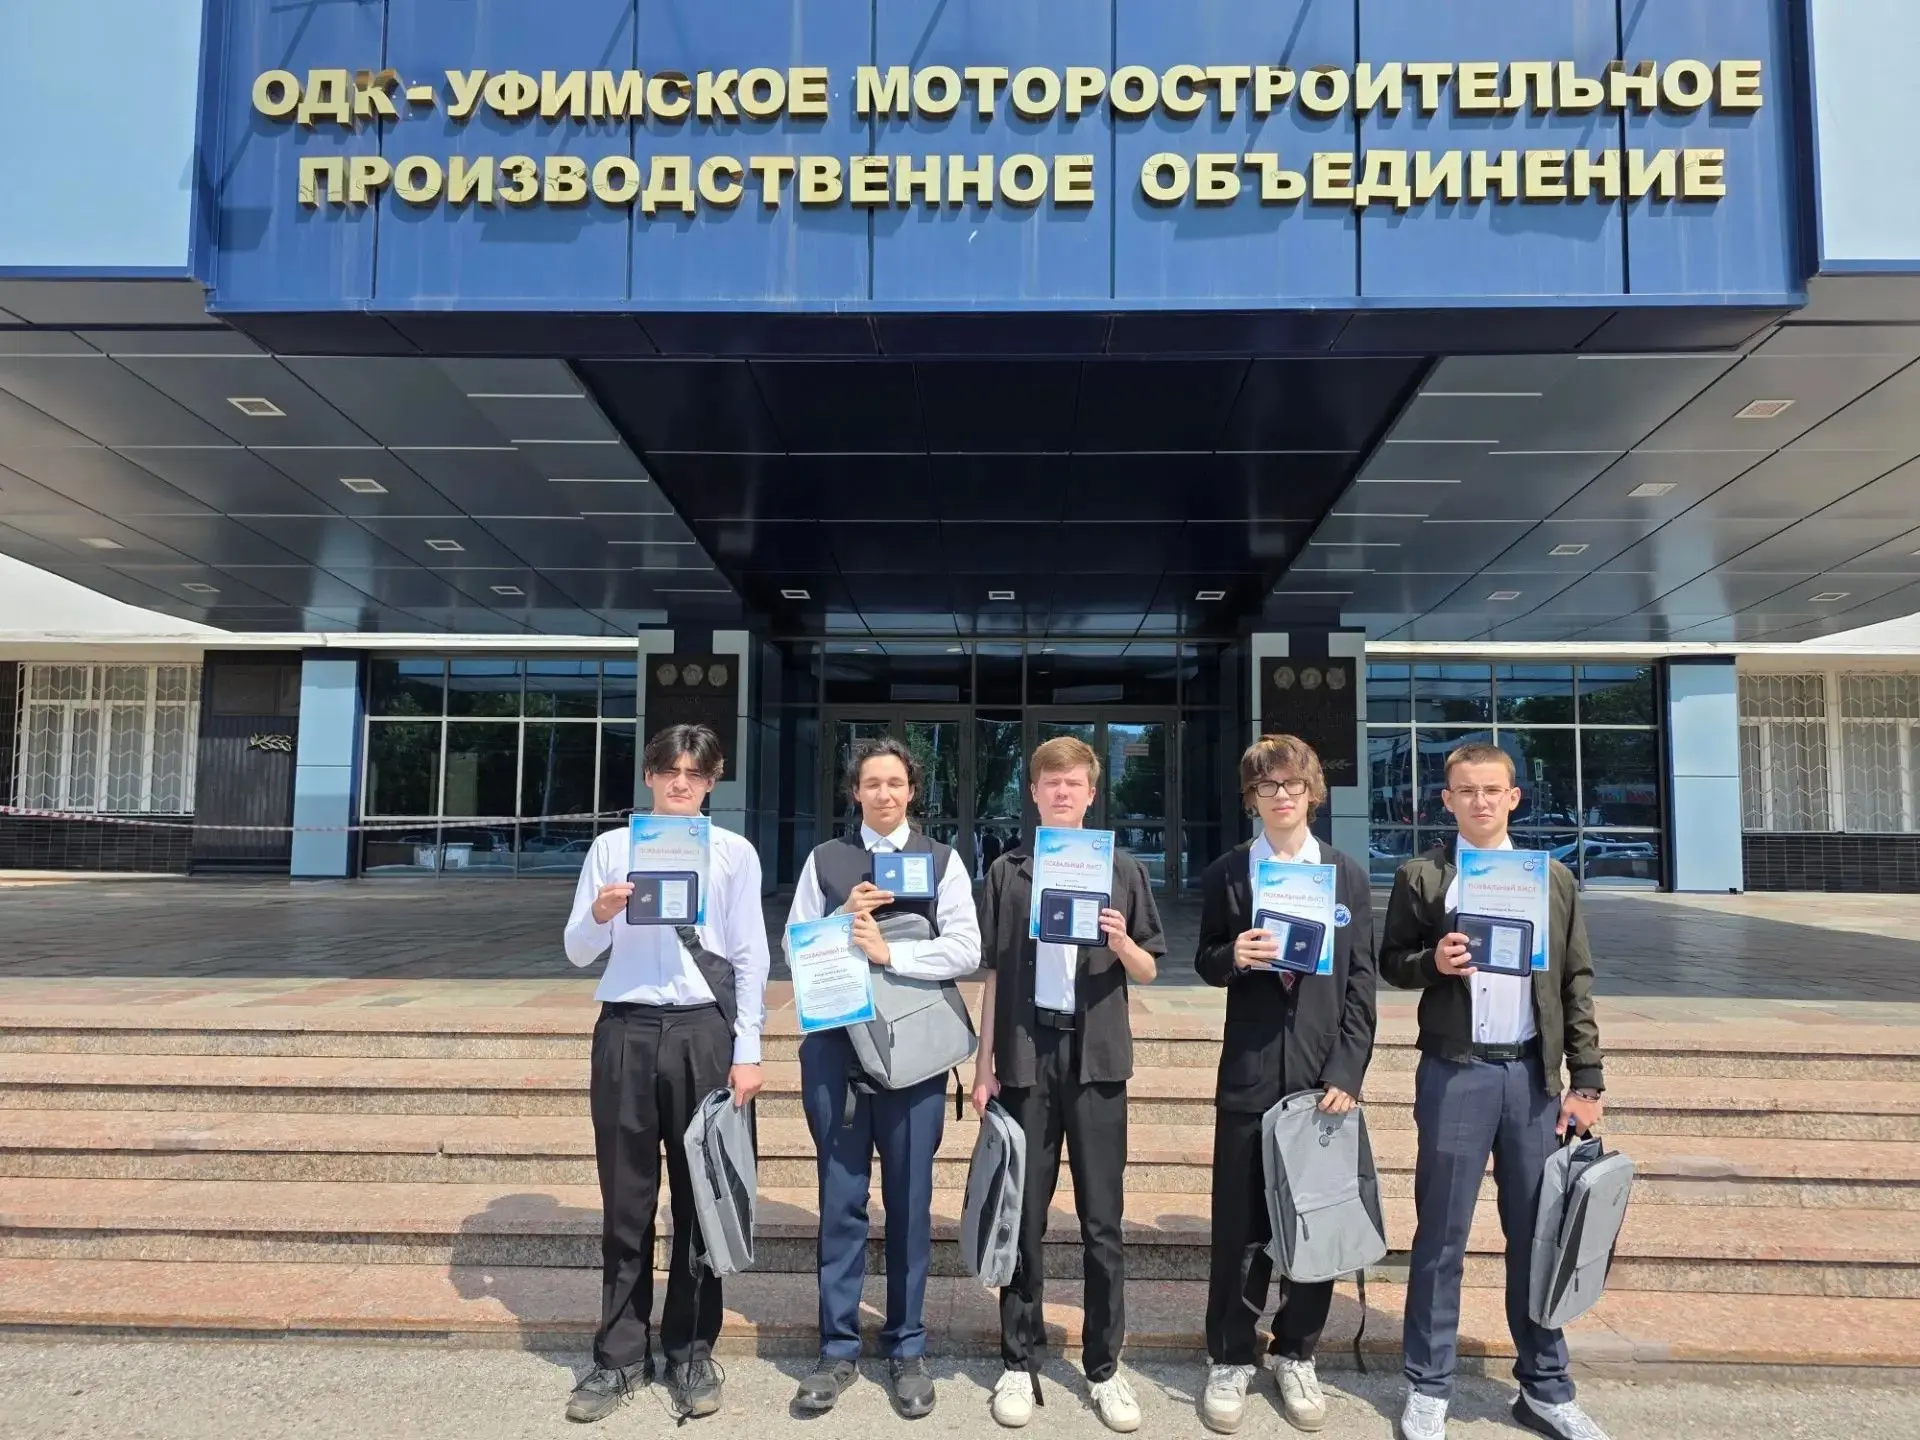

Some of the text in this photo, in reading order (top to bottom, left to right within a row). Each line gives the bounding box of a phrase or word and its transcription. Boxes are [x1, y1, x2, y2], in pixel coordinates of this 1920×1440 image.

[855, 59, 1764, 116] МОТОРОСТРОИТЕЛЬНОЕ
[299, 147, 1727, 214] ПРОИЗВОДСТВЕННОЕ ОБЪЕДИНЕНИЕ
